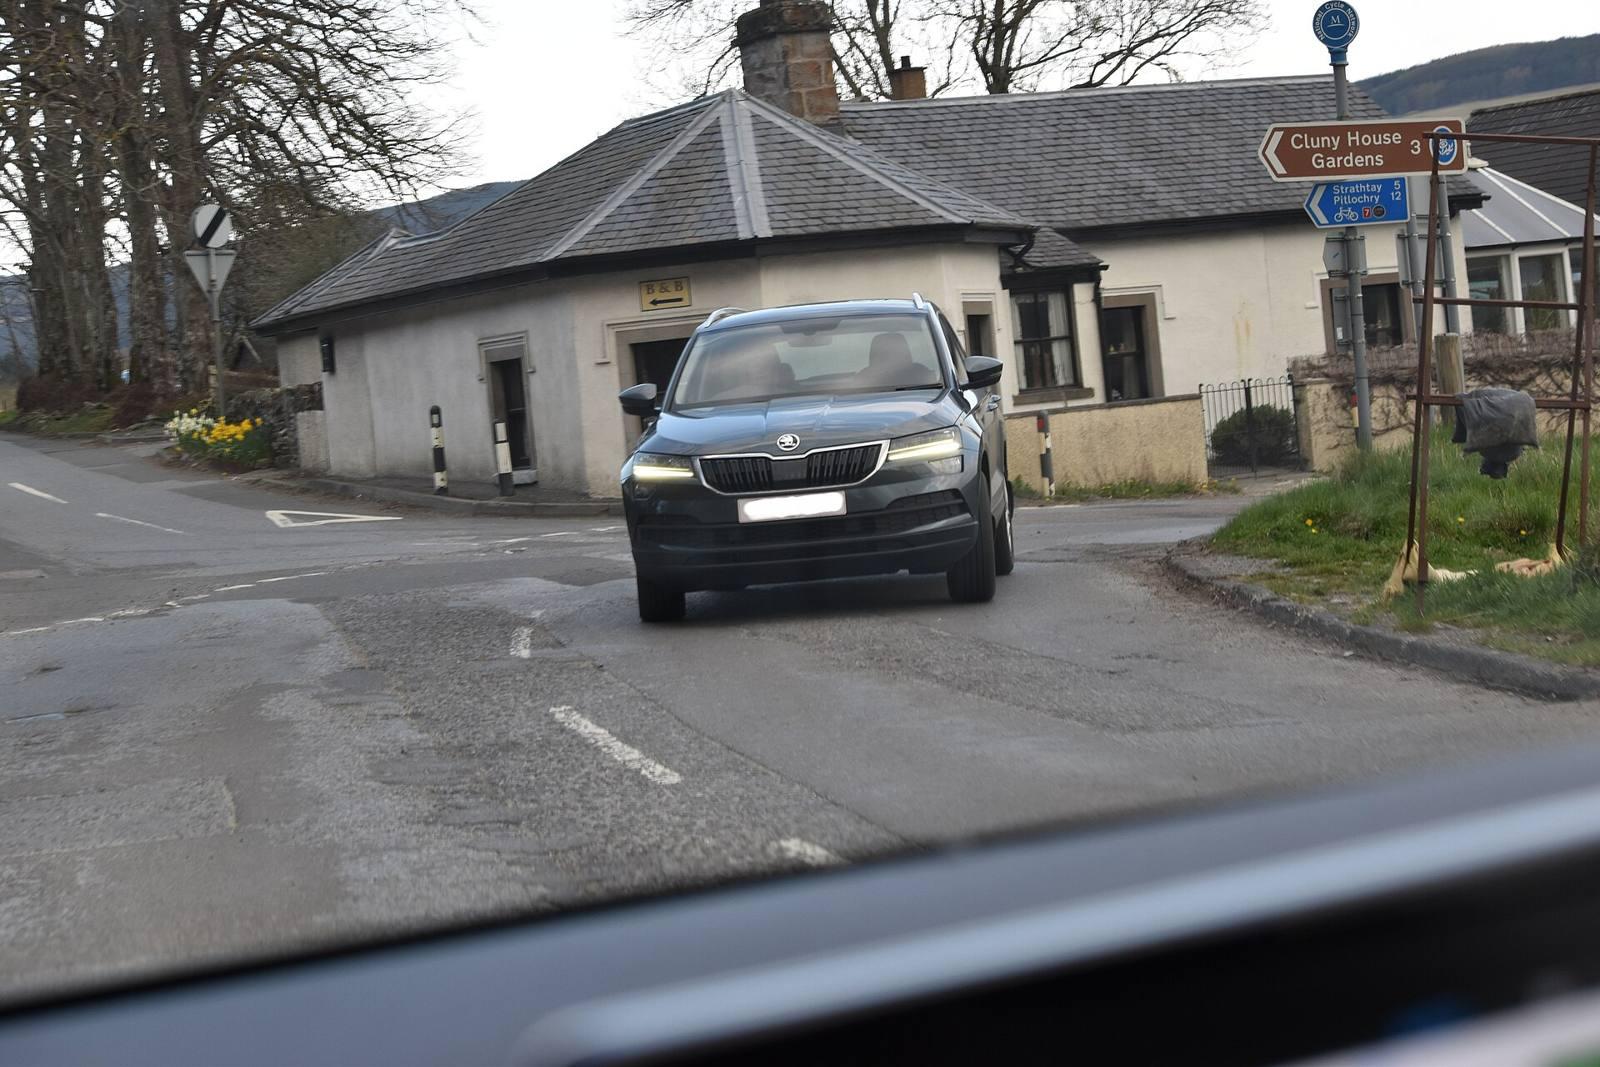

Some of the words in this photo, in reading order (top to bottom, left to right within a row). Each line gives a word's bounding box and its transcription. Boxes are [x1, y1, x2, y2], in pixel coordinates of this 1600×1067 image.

[1315, 10, 1325, 41] National
[1325, 1, 1345, 10] Cycle
[1346, 8, 1357, 38] Network
[1330, 15, 1341, 24] M
[1290, 133, 1340, 150] Cluny
[1347, 131, 1402, 146] House
[1410, 139, 1421, 155] 3
[1311, 152, 1384, 169] Gardens
[1333, 183, 1382, 194] Strathtay
[1394, 180, 1401, 190] 5
[1333, 193, 1380, 205] Pitlochry
[1390, 191, 1402, 201] 12
[646, 284, 655, 294] B
[659, 282, 671, 293] &
[674, 280, 683, 291] B
